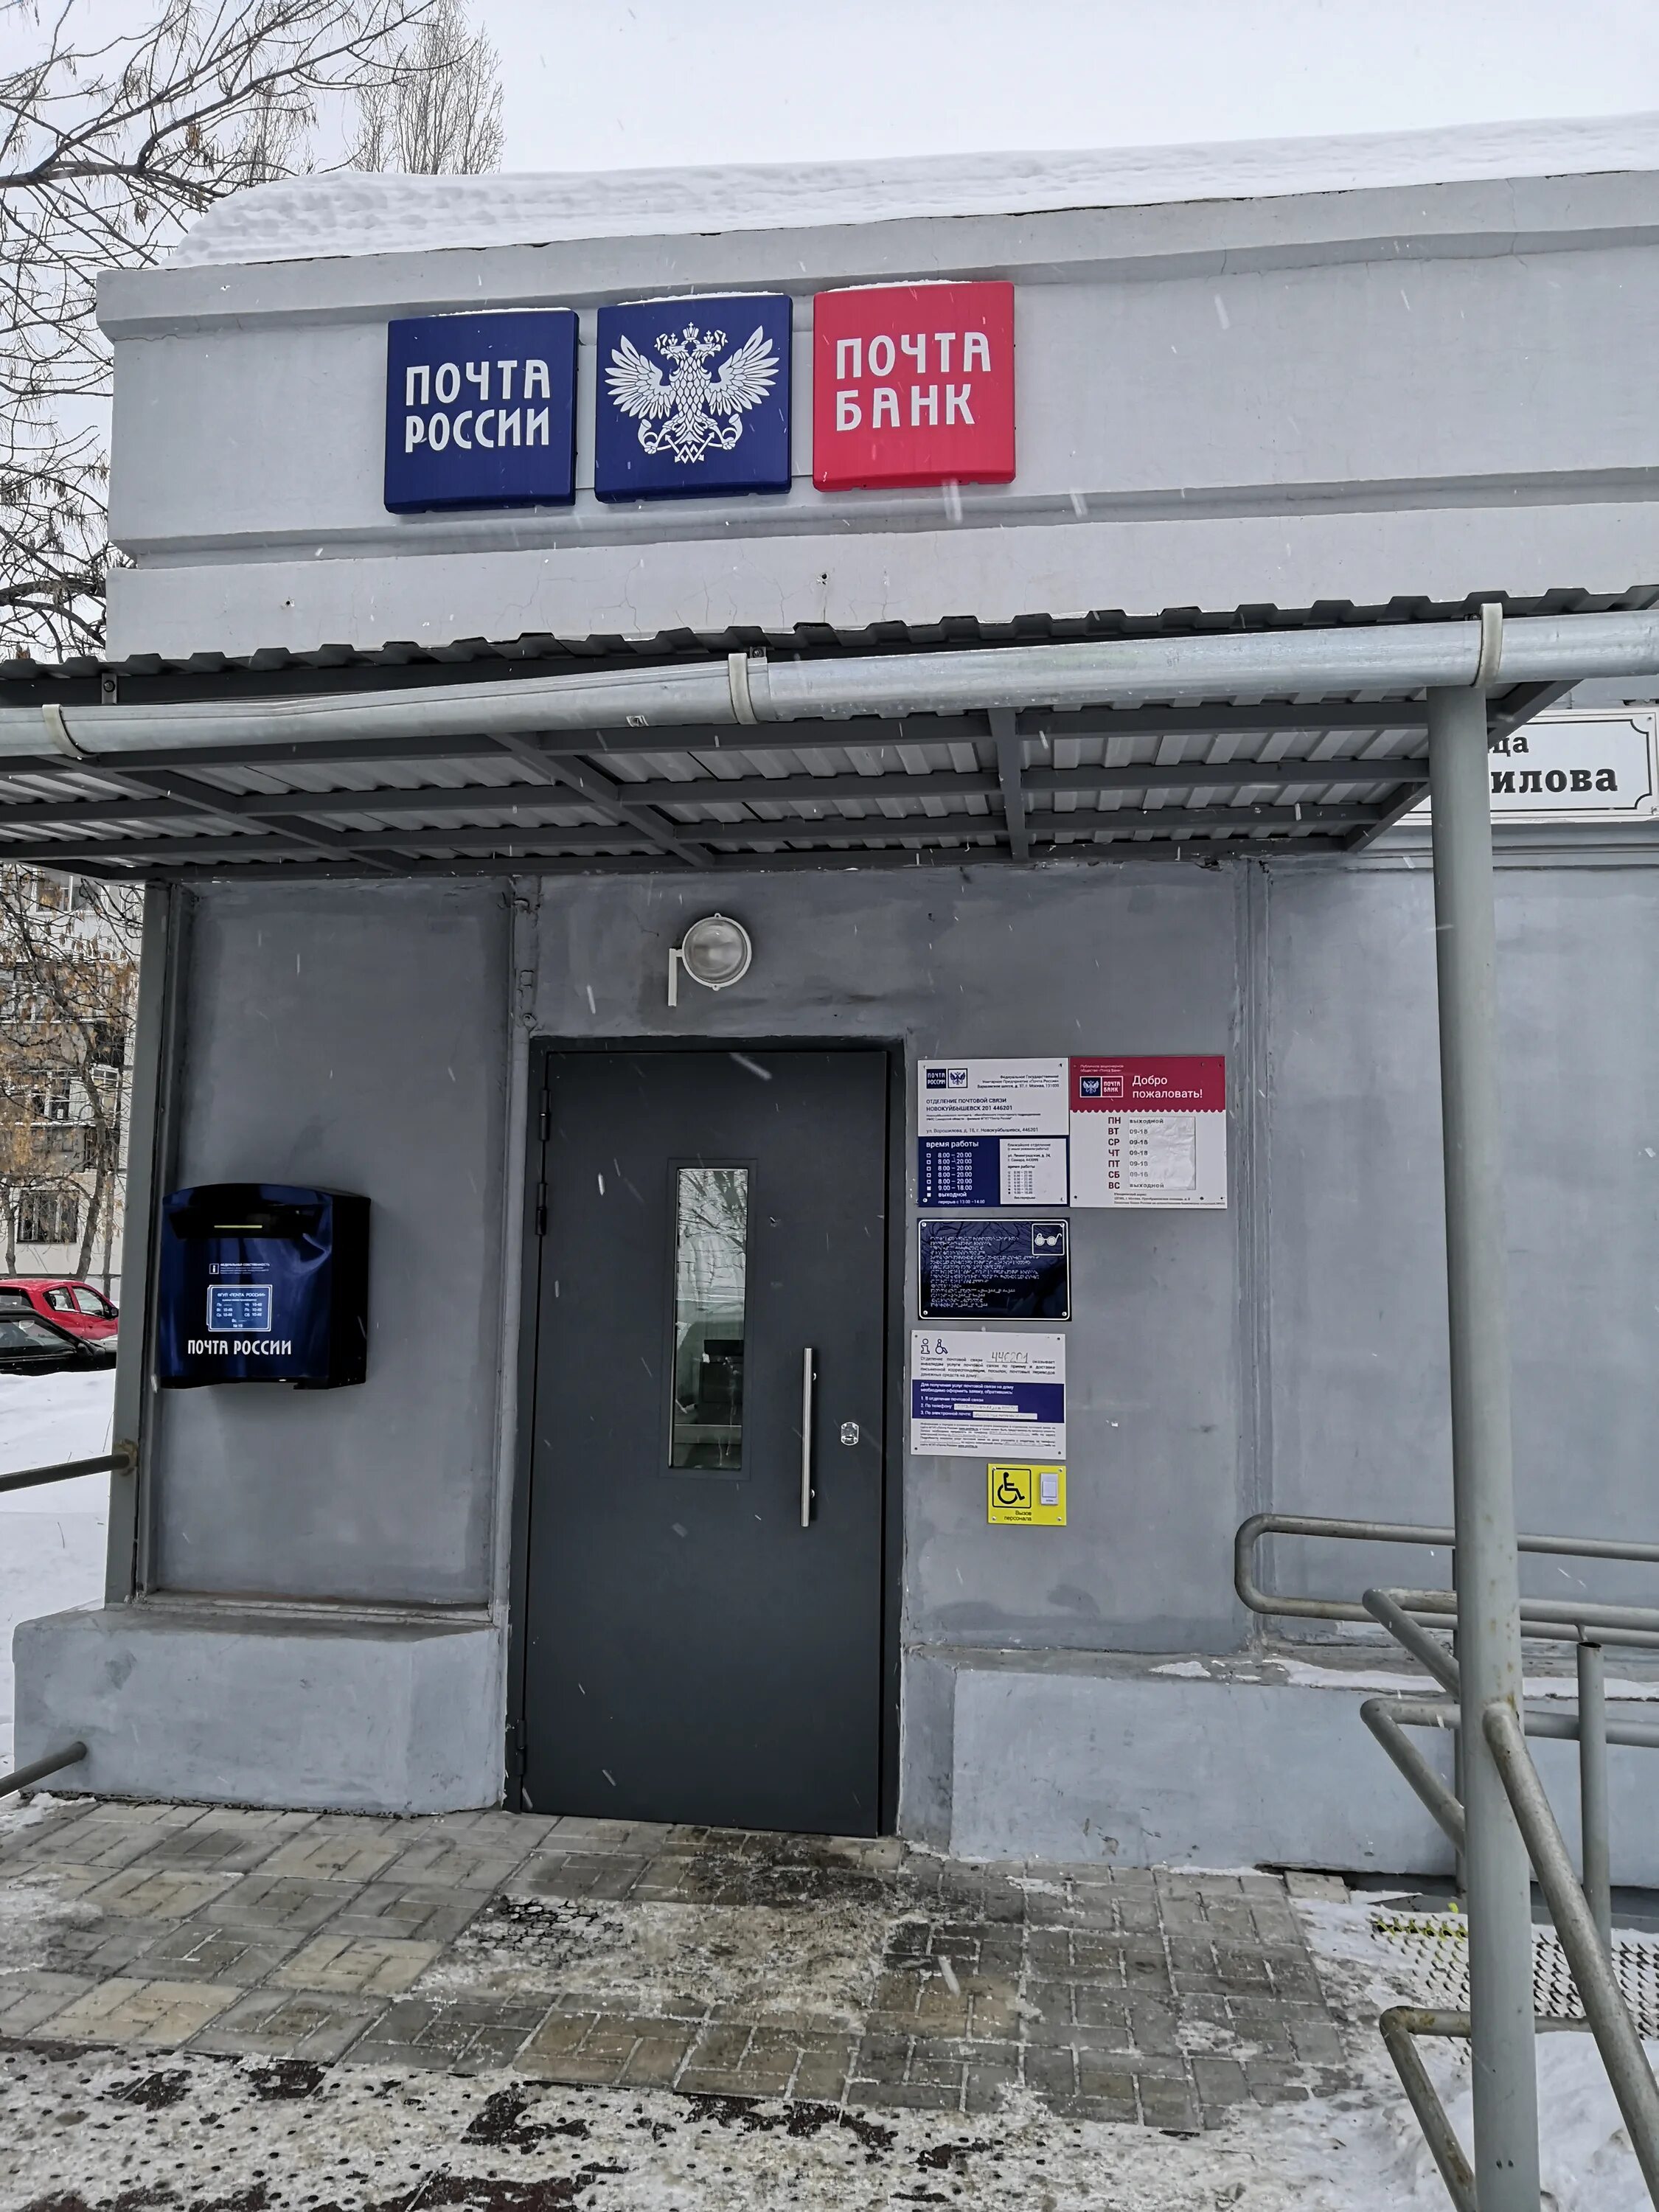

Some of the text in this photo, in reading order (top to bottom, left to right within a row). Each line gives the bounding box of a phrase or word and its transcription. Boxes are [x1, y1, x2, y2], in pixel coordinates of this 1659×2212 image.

[837, 332, 991, 380] ПОЧТА
[406, 359, 551, 406] ПОЧТА
[837, 383, 975, 431] БАНК
[406, 406, 549, 453] РОССИИ
[1492, 736, 1529, 757] ца
[1490, 768, 1618, 794] илова
[1132, 1075, 1168, 1087] Добро
[1133, 1089, 1203, 1099] пожаловать!
[1108, 1116, 1121, 1124] ПН
[950, 1140, 979, 1149] работы
[1108, 1149, 1120, 1157] ЧТ
[187, 1340, 292, 1355] ПОЧТА РОССИИ
